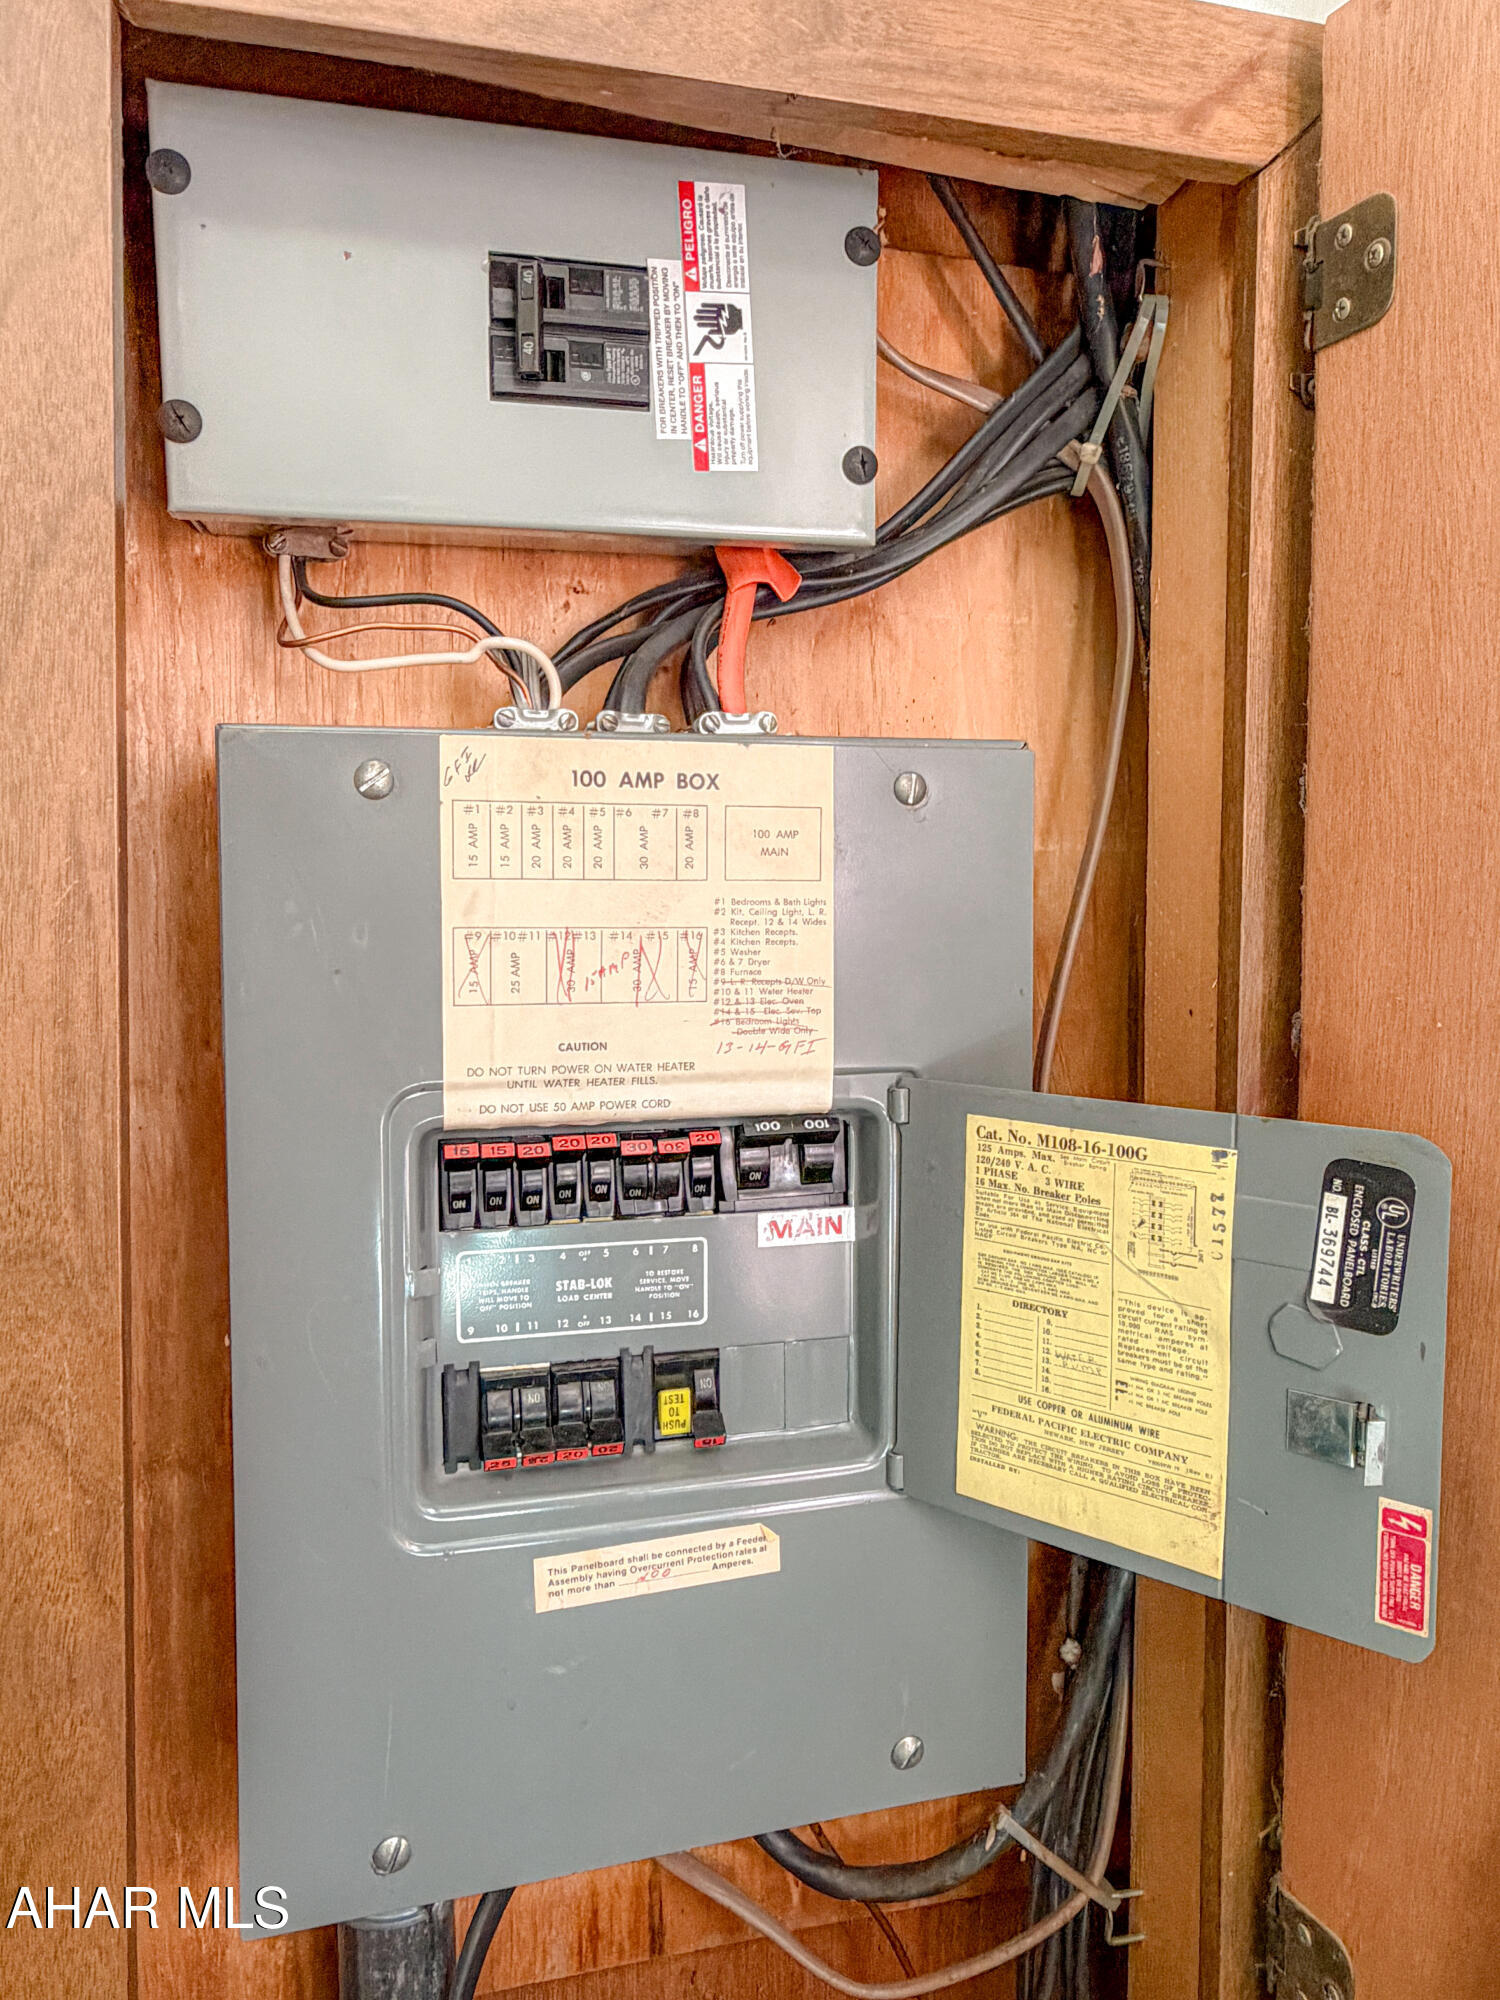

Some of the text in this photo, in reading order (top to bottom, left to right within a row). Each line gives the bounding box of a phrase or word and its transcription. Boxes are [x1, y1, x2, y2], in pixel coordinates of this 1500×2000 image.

[682, 199, 695, 261] PELIGRO
[523, 270, 534, 284] 40
[651, 266, 659, 306] POSITION
[674, 303, 681, 315] TO
[675, 318, 683, 339] THEN
[523, 342, 534, 354] 40
[661, 267, 677, 434] IN CENTER, RESET BREAKER BY MOVING
[679, 388, 685, 398] TO
[693, 375, 704, 432] DANGER
[572, 770, 720, 790] 100 AMP BOX
[464, 805, 480, 814] #1
[496, 805, 513, 815] #2
[527, 806, 544, 816] #3
[558, 807, 575, 816] #4
[589, 808, 606, 817] #5
[616, 808, 632, 817] #6
[652, 809, 668, 819] #7
[683, 809, 699, 819] #8
[753, 829, 799, 839] 100 AMP
[468, 823, 479, 867] 15 AMP
[500, 824, 510, 867] 15 AMP
[531, 824, 541, 868] 20 AMP
[563, 825, 572, 868] 20 AMP
[593, 825, 603, 868] 20 AMP
[639, 826, 649, 869] 30 AMP
[685, 826, 694, 869] 20 AMP
[761, 848, 789, 856] MAIN
[731, 898, 771, 906] Bedrooms
[783, 898, 801, 906] Bath
[804, 899, 827, 907] Lights
[518, 931, 540, 941] #11
[610, 931, 633, 941] #14
[714, 928, 725, 936] #3
[765, 928, 798, 936] Recepts.
[714, 948, 725, 956] #5
[511, 952, 521, 994] 25 AMP
[558, 1042, 608, 1052] CAUTION
[467, 1062, 696, 1077] DO NOT TURN POWER ON WATER HEATER
[507, 1076, 658, 1089] UNTIL WATER HEATER FILLS.
[479, 1099, 671, 1115] DO NOT USE 50 AMP POWER CORD
[755, 1121, 781, 1132] 100
[558, 1139, 580, 1148] 20
[591, 1136, 611, 1144] 20
[695, 1134, 715, 1142] 20
[976, 1126, 1147, 1161] Cat. No. M108-16-100G
[490, 1146, 507, 1155] 15
[523, 1146, 544, 1155] 20
[749, 1172, 761, 1180] ON
[595, 1185, 608, 1194] ON
[1332, 1178, 1343, 1193] NO.
[452, 1200, 466, 1209] ON
[489, 1197, 503, 1205] ON
[769, 1215, 842, 1239] MAIN
[1340, 1184, 1364, 1307] ENCLOSED PANELBOARD
[1317, 1229, 1338, 1287] 369744
[1378, 1232, 1396, 1308] LABORATORIES
[555, 1277, 613, 1291] STAB-LOK
[557, 1294, 580, 1302] LOAD
[1012, 1300, 1068, 1318] DIRECTORY
[663, 1393, 685, 1405] TEST
[668, 1407, 680, 1416] TO
[1018, 1396, 1160, 1439] USE COPPER OR ALUMINUM WIRE
[662, 1419, 686, 1431] PUSH
[992, 1405, 1189, 1464] FEDERAL PACIFIC ELECTRIC COMPANY
[548, 1566, 567, 1576] This
[571, 1558, 624, 1572] Panelboard
[628, 1554, 648, 1564] shall
[651, 1551, 662, 1559] be
[665, 1543, 712, 1558] connected
[716, 1542, 726, 1551] by
[712, 1558, 753, 1570] Amperes.
[548, 1573, 593, 1587] Assembly
[596, 1569, 627, 1579] having
[630, 1557, 684, 1574] Overcurrent
[687, 1551, 733, 1564] Protection
[548, 1581, 615, 1598] not more than
[1410, 1564, 1422, 1611] DANGER
